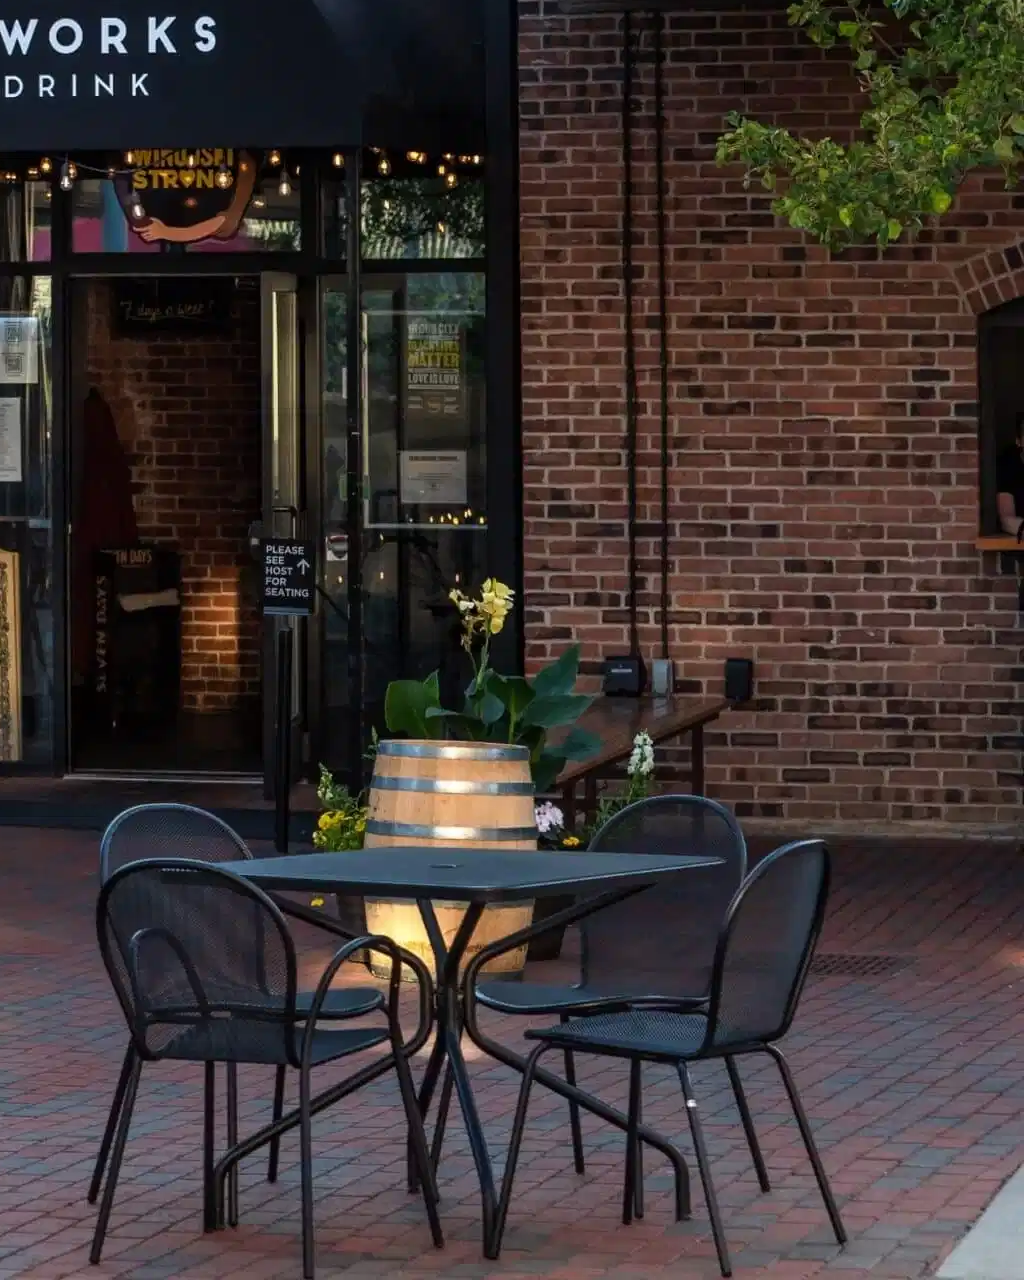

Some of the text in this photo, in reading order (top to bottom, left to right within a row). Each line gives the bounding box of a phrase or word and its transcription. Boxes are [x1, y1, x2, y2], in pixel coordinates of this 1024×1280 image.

[4, 73, 149, 98] DRINK
[266, 545, 304, 555] PLEASE
[265, 556, 285, 565] SEE
[265, 566, 293, 576] HOST
[265, 577, 287, 586] FOR
[265, 587, 309, 598] SEATING
